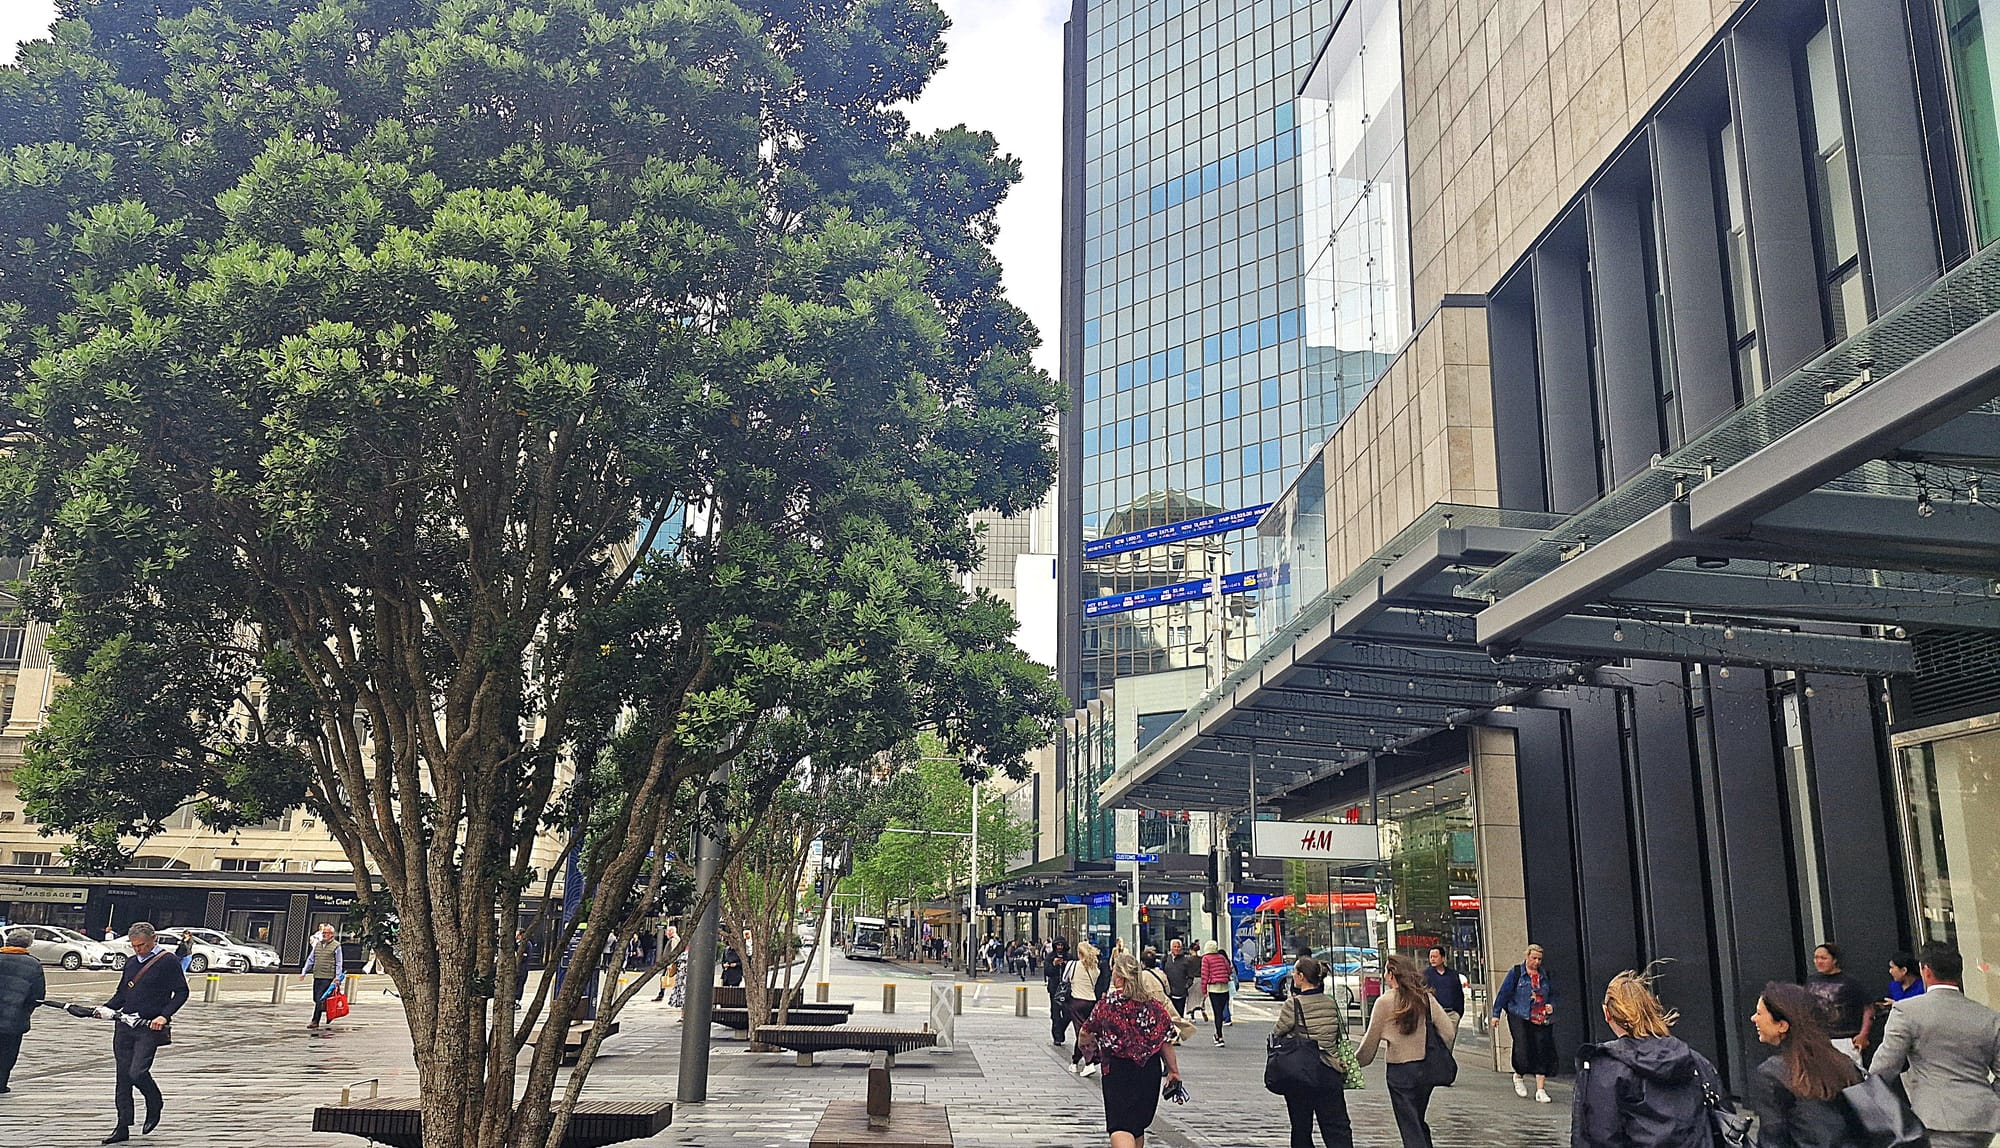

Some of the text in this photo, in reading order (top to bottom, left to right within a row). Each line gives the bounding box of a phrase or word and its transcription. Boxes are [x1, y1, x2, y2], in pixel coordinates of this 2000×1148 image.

[1301, 829, 1333, 852] H&M
[1146, 894, 1170, 905] ANZ
[1237, 896, 1249, 904] FC
